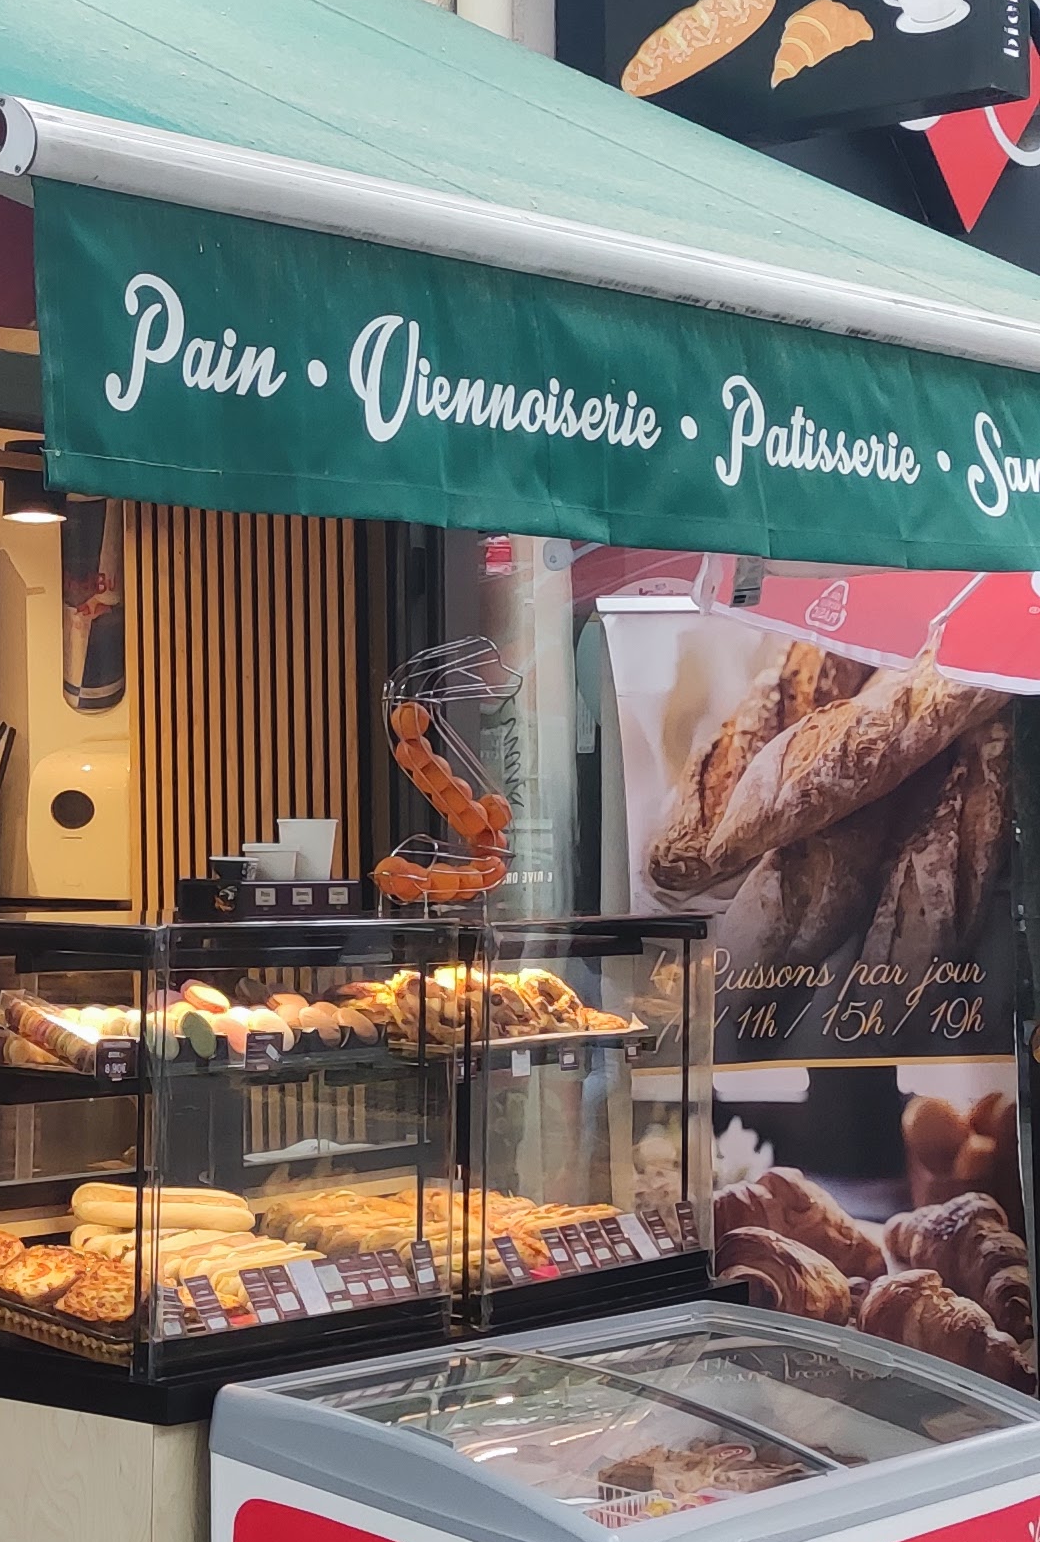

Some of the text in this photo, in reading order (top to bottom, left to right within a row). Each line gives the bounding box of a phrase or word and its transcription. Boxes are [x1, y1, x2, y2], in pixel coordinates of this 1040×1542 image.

[106, 273, 288, 413] Pain
[349, 313, 662, 450] Viennoiserie
[716, 373, 922, 488] Patisserie
[837, 956, 909, 1002] par
[905, 956, 987, 1006] jour
[737, 1001, 778, 1040] 11h
[821, 998, 885, 1042] 15h
[929, 996, 985, 1040] 19h
